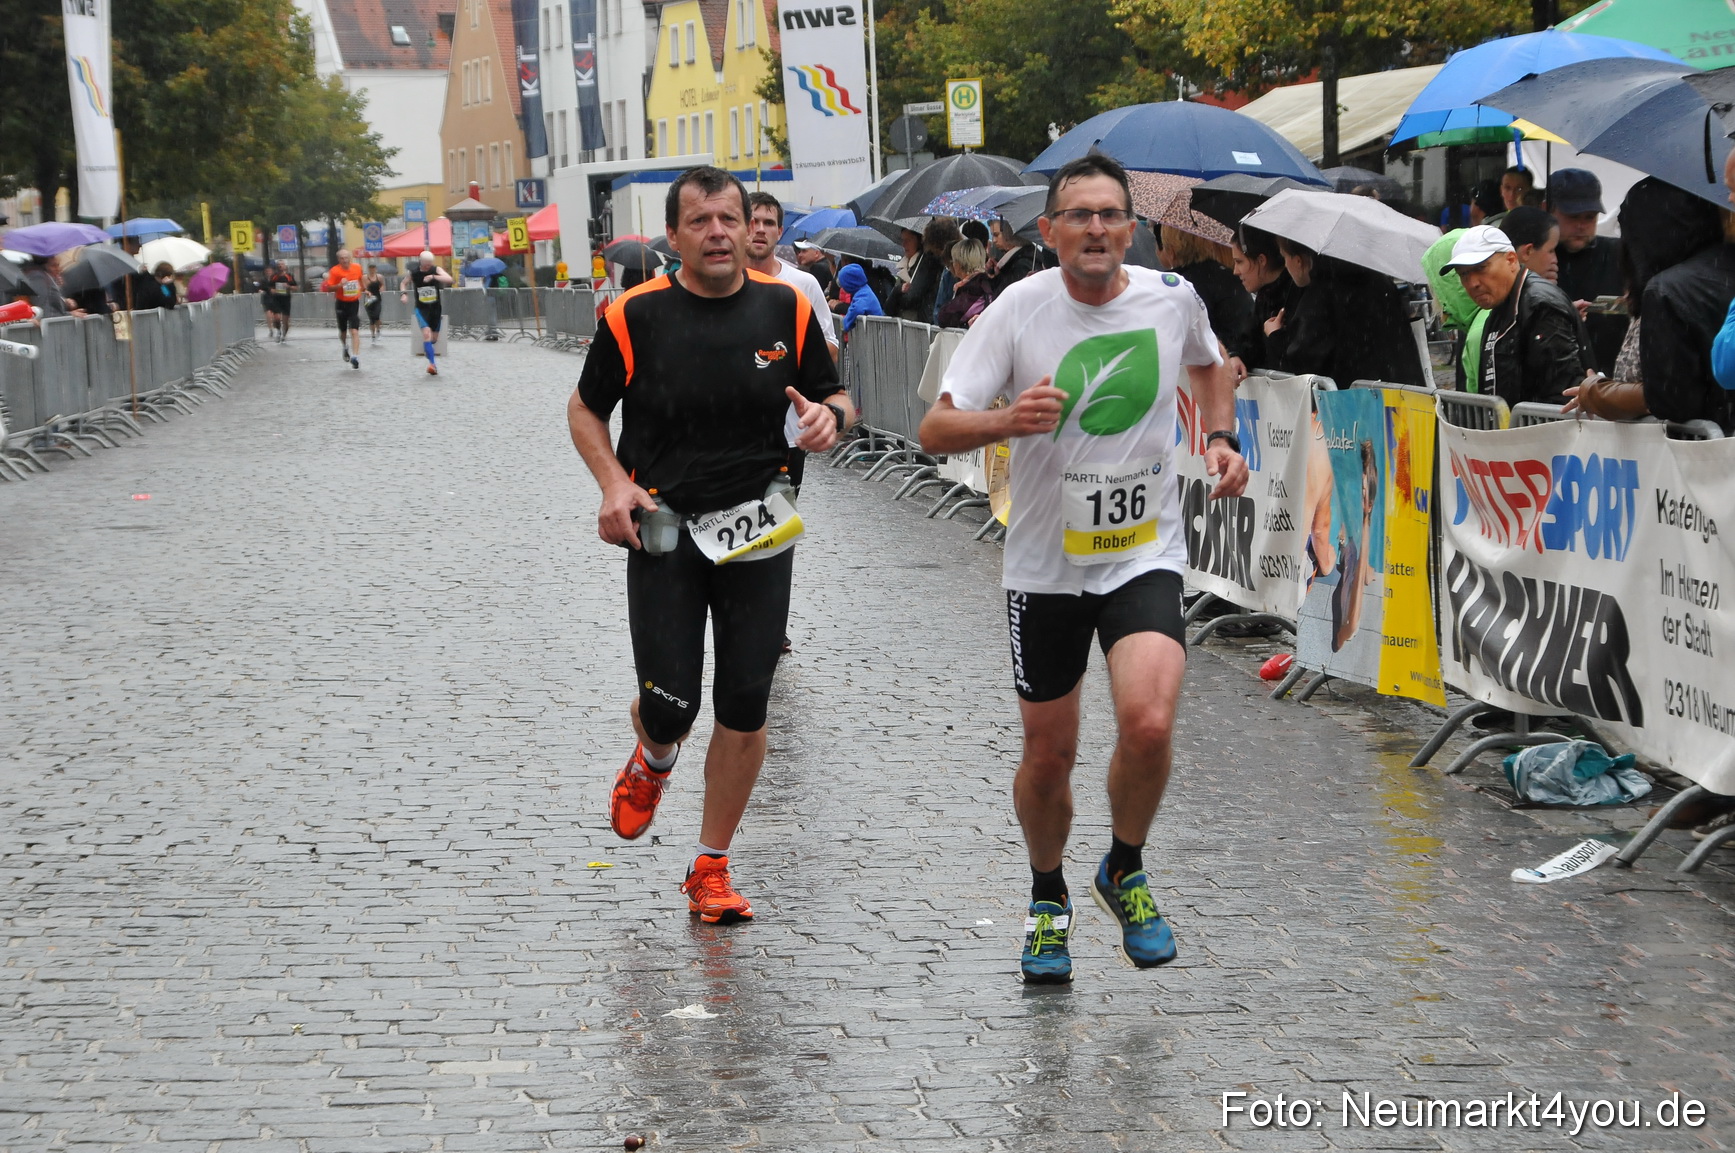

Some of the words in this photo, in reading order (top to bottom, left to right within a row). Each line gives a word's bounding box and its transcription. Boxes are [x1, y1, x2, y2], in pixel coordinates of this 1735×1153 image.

[236, 231, 247, 245] D
[514, 228, 524, 242] D
[1064, 473, 1102, 484] PARTL
[1105, 468, 1149, 484] Neumarkt
[1086, 484, 1146, 526] 136
[692, 516, 723, 536] PARTL
[717, 504, 777, 551] 224
[1093, 532, 1136, 550] Robert
[1660, 559, 1675, 597] Im
[1662, 607, 1682, 646] der
